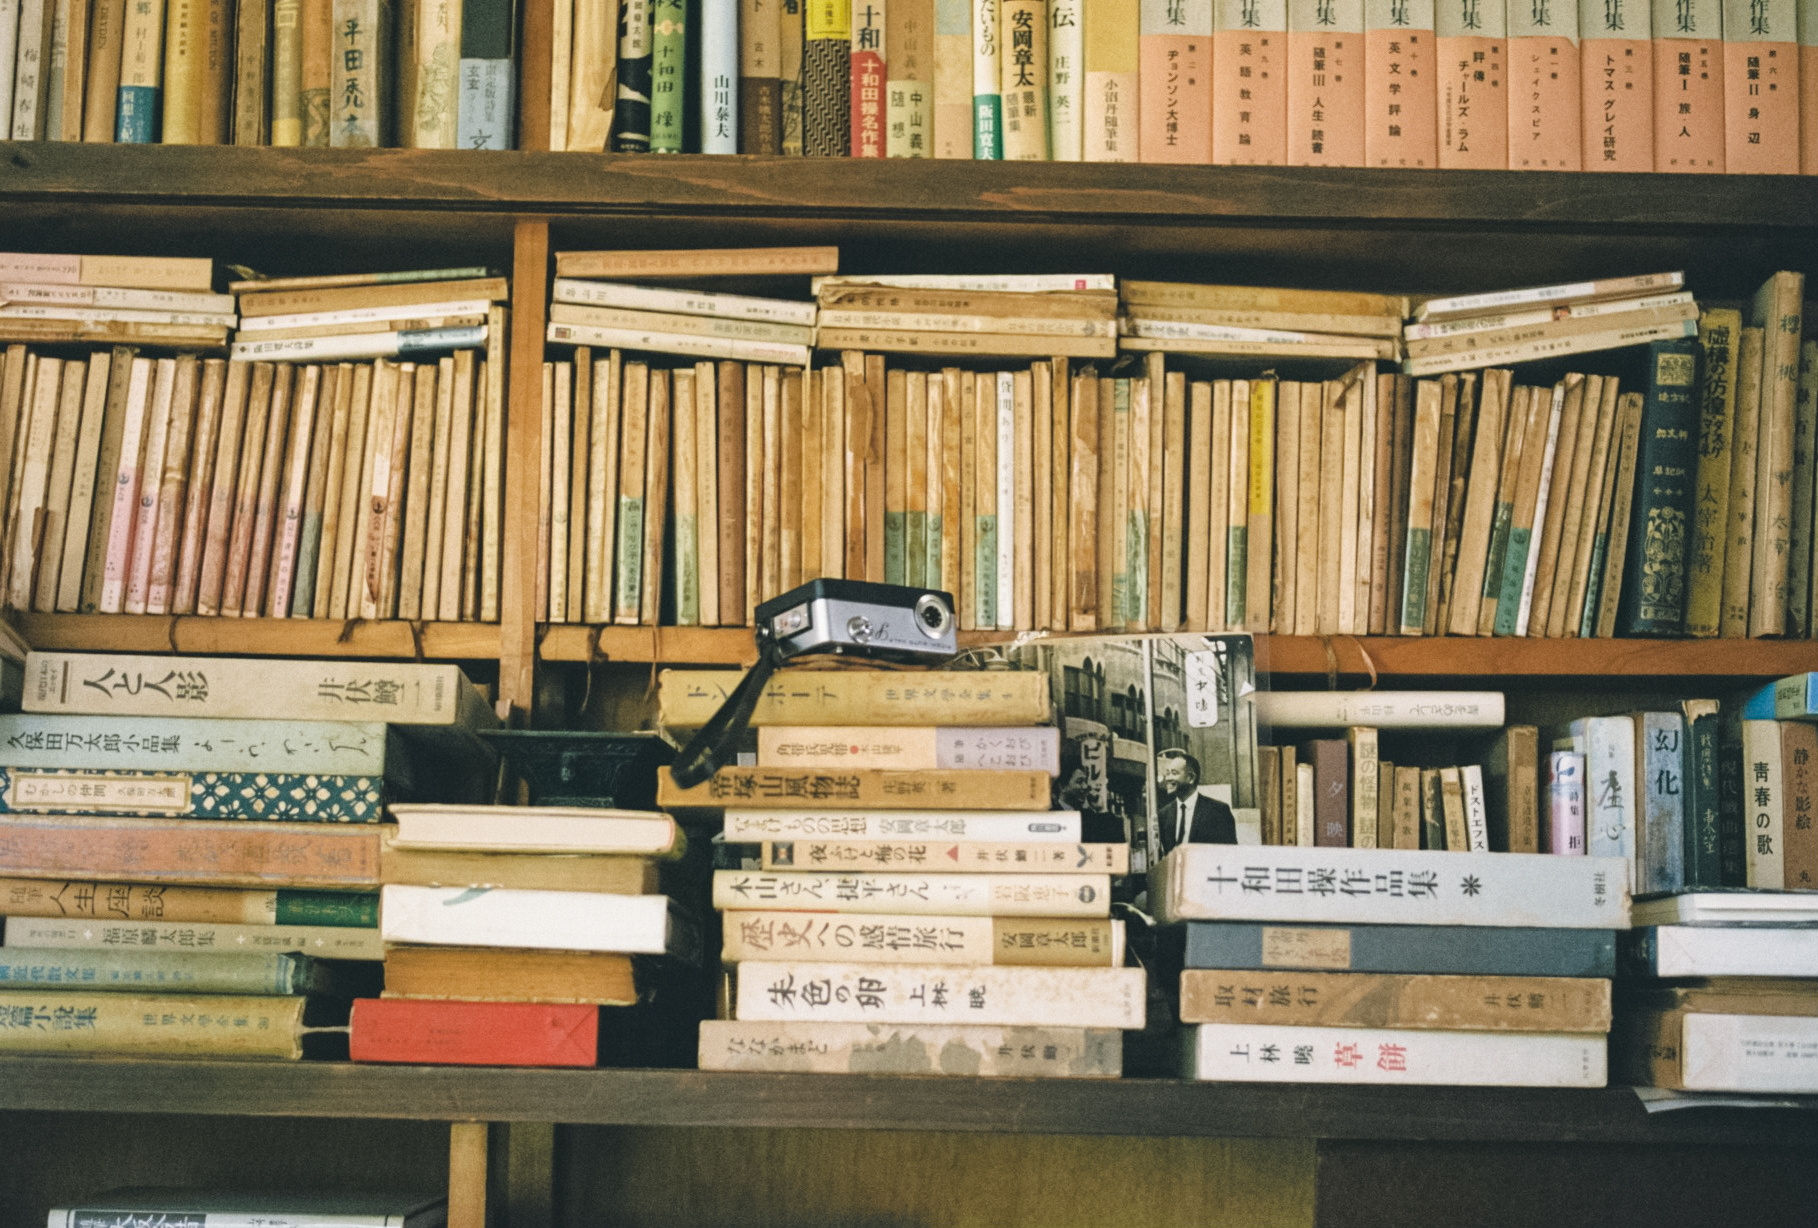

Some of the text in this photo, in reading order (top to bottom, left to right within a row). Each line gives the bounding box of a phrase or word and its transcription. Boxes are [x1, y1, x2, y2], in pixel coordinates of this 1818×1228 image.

[858, 5, 880, 48] 十和
[1239, 43, 1252, 145] 英語教育論
[1388, 42, 1401, 137] 英文学評論
[1532, 54, 1541, 140] シェイクスピア
[910, 91, 922, 157] 中山義
[83, 667, 208, 702] 人と人影
[317, 677, 423, 706] 井伏鱒二
[7, 731, 180, 753] 久保田万太郎小品集
[1655, 728, 1680, 795] 幻化
[25, 784, 107, 798] むかしの仲間
[1794, 748, 1812, 829] 静かな影絵
[735, 817, 965, 836] なまけものの思想 安岡章太郎
[1328, 781, 1344, 837] 夕映
[1471, 785, 1485, 850] ドストエフス
[1754, 762, 1774, 855] 青春の歌
[809, 845, 927, 864] 夜ふけと梅の花
[49, 882, 166, 918] 人生座談
[729, 877, 929, 900] 木山さん、捷平さん
[1206, 866, 1438, 899] 十和田操作品集
[102, 927, 216, 948] 福原麟太郎集
[740, 917, 1086, 951] 歴史への感情旅行 安岡章太郎
[766, 974, 886, 1010] 朱色の卵
[1214, 985, 1318, 1008] 取材旅行
[727, 1038, 827, 1056] ななかまど
[1334, 1041, 1407, 1072] 草餅
